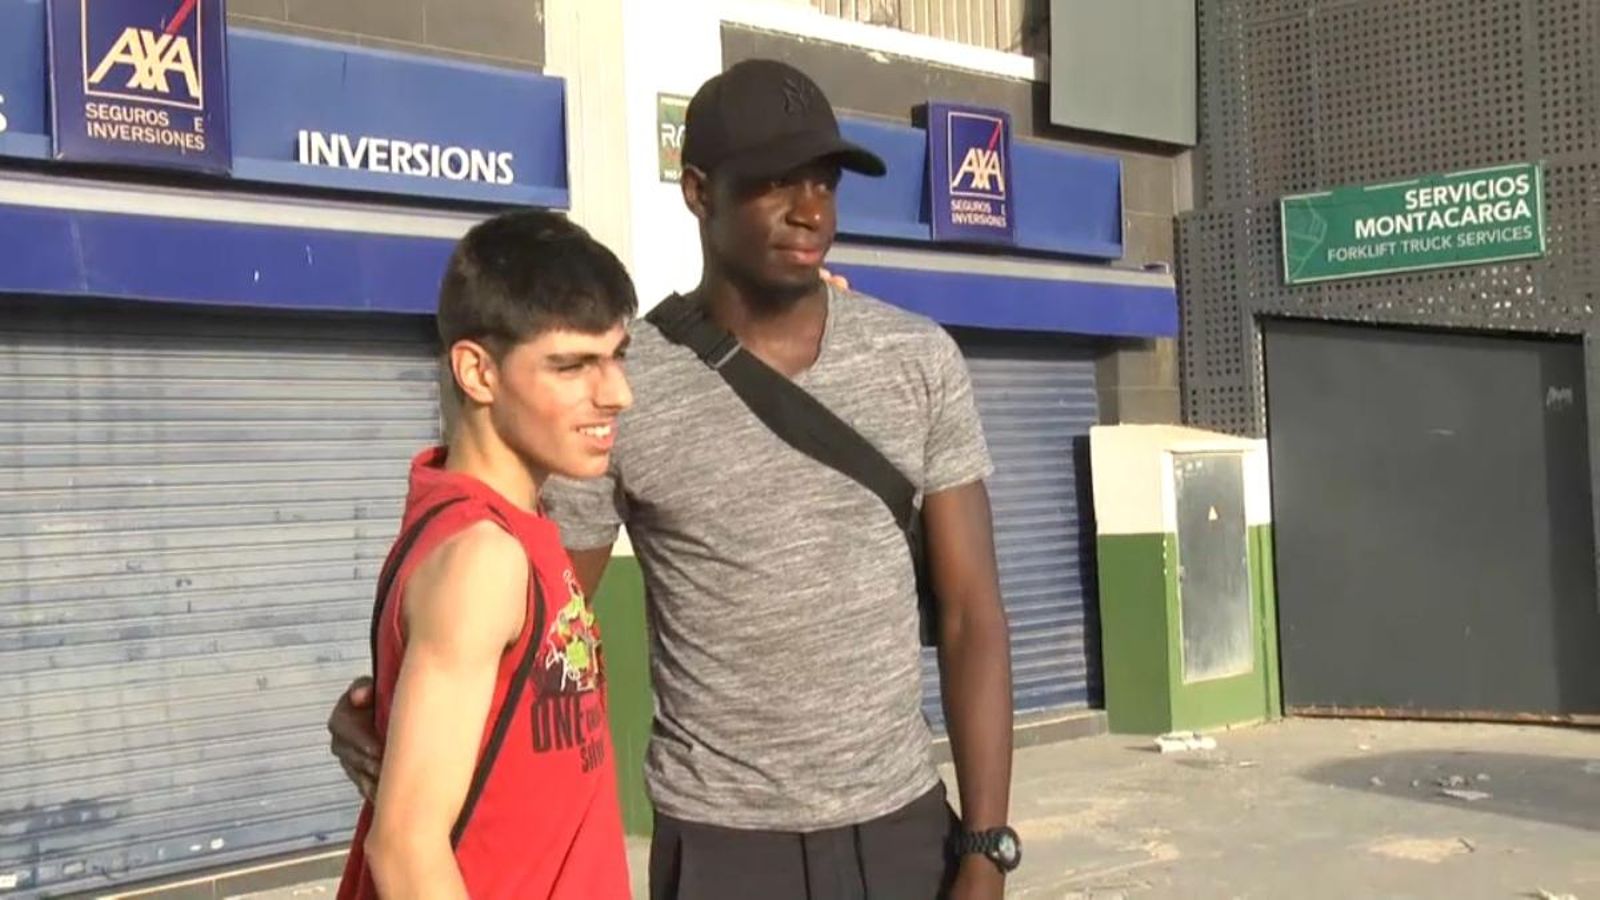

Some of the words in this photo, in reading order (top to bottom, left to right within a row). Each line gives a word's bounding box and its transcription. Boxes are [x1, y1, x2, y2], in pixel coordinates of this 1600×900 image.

[87, 26, 201, 98] AXA
[85, 102, 170, 127] SEGUROS
[193, 116, 204, 133] E
[86, 121, 205, 151] INVERSIONES
[298, 130, 514, 185] INVERSIONS
[951, 147, 1005, 192] AXA
[1404, 173, 1530, 210] SERVICIOS
[1354, 198, 1532, 239] MONTACARGA
[1327, 241, 1397, 262] FORKLIFT
[1400, 234, 1452, 255] TRUCK
[1456, 224, 1533, 249] SERVICES
